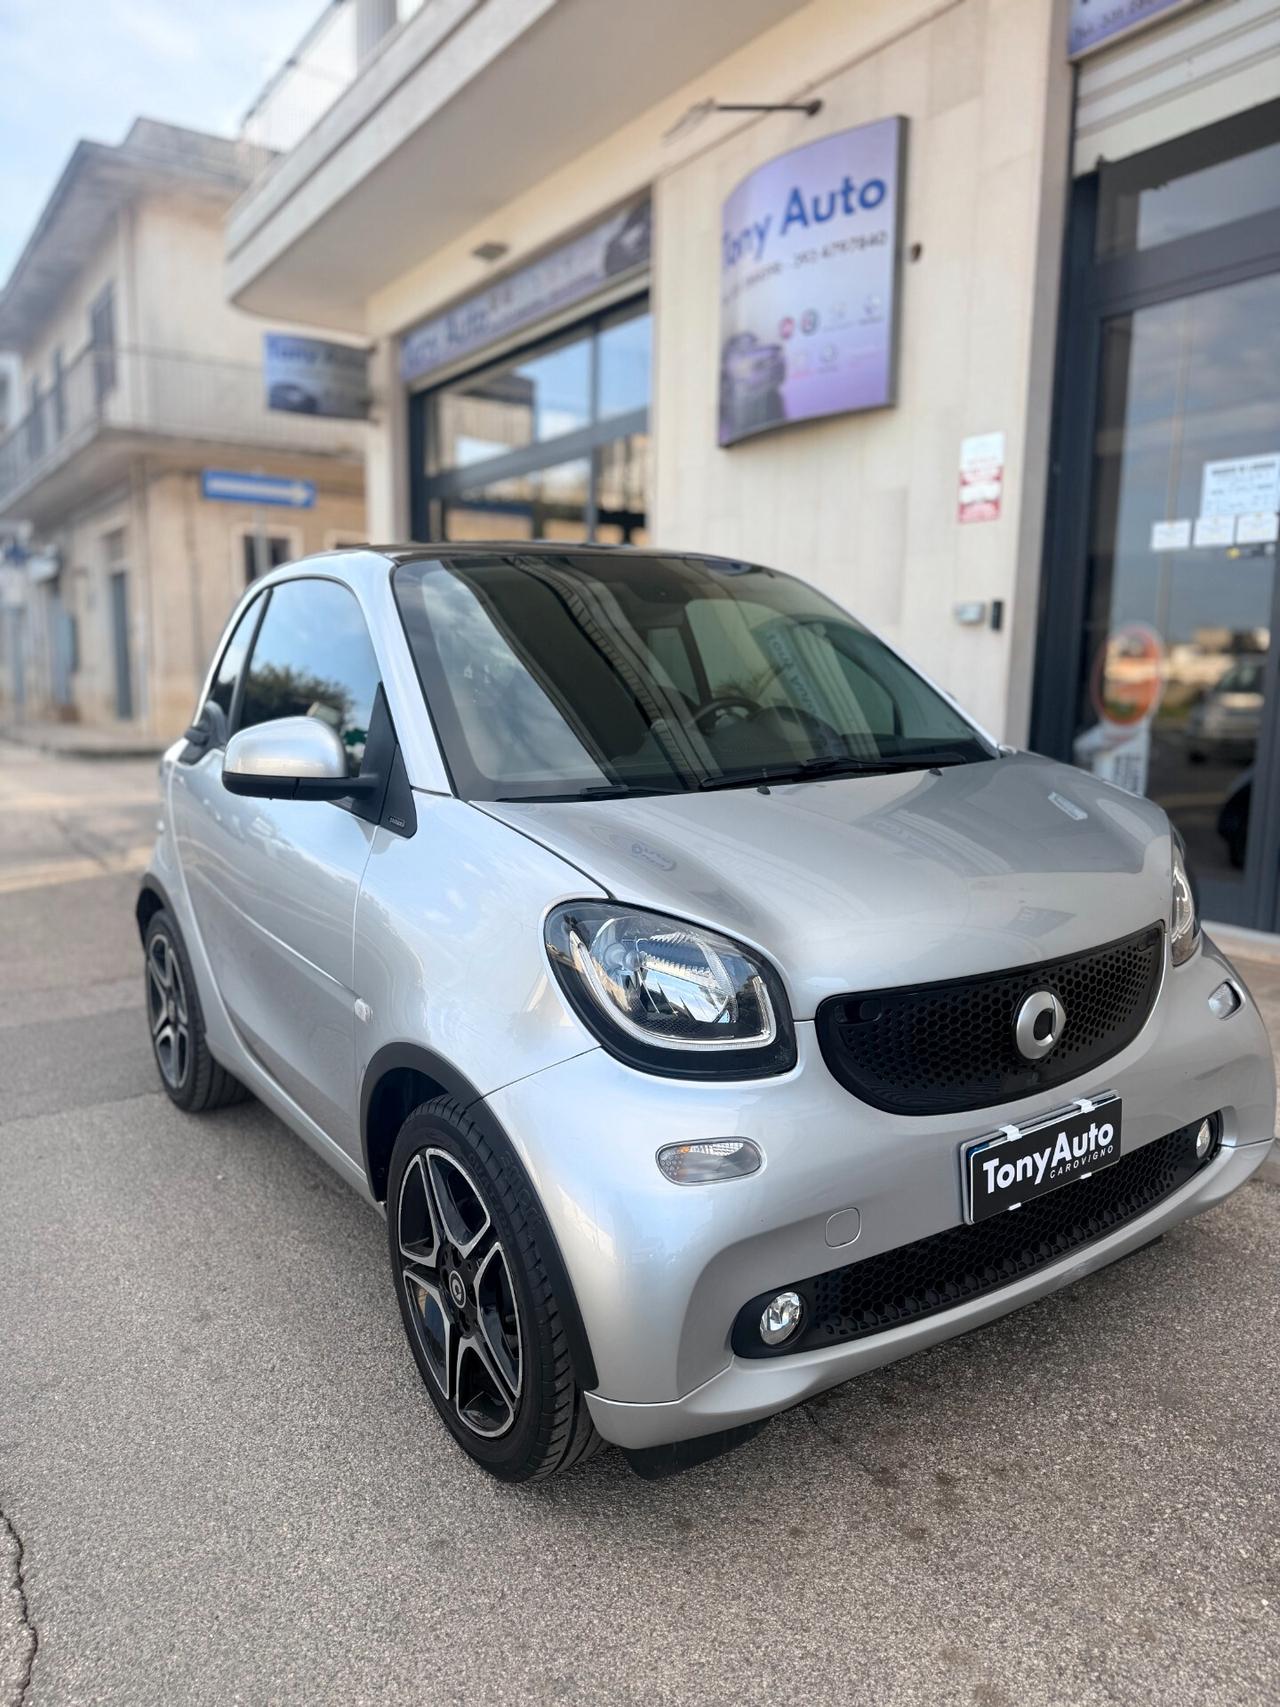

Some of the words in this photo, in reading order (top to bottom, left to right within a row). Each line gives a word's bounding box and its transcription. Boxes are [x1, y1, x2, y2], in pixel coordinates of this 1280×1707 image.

[779, 174, 887, 237] Auto
[982, 1122, 1114, 1194] TonyAuto
[1049, 1145, 1114, 1179] CAROVIGNO
